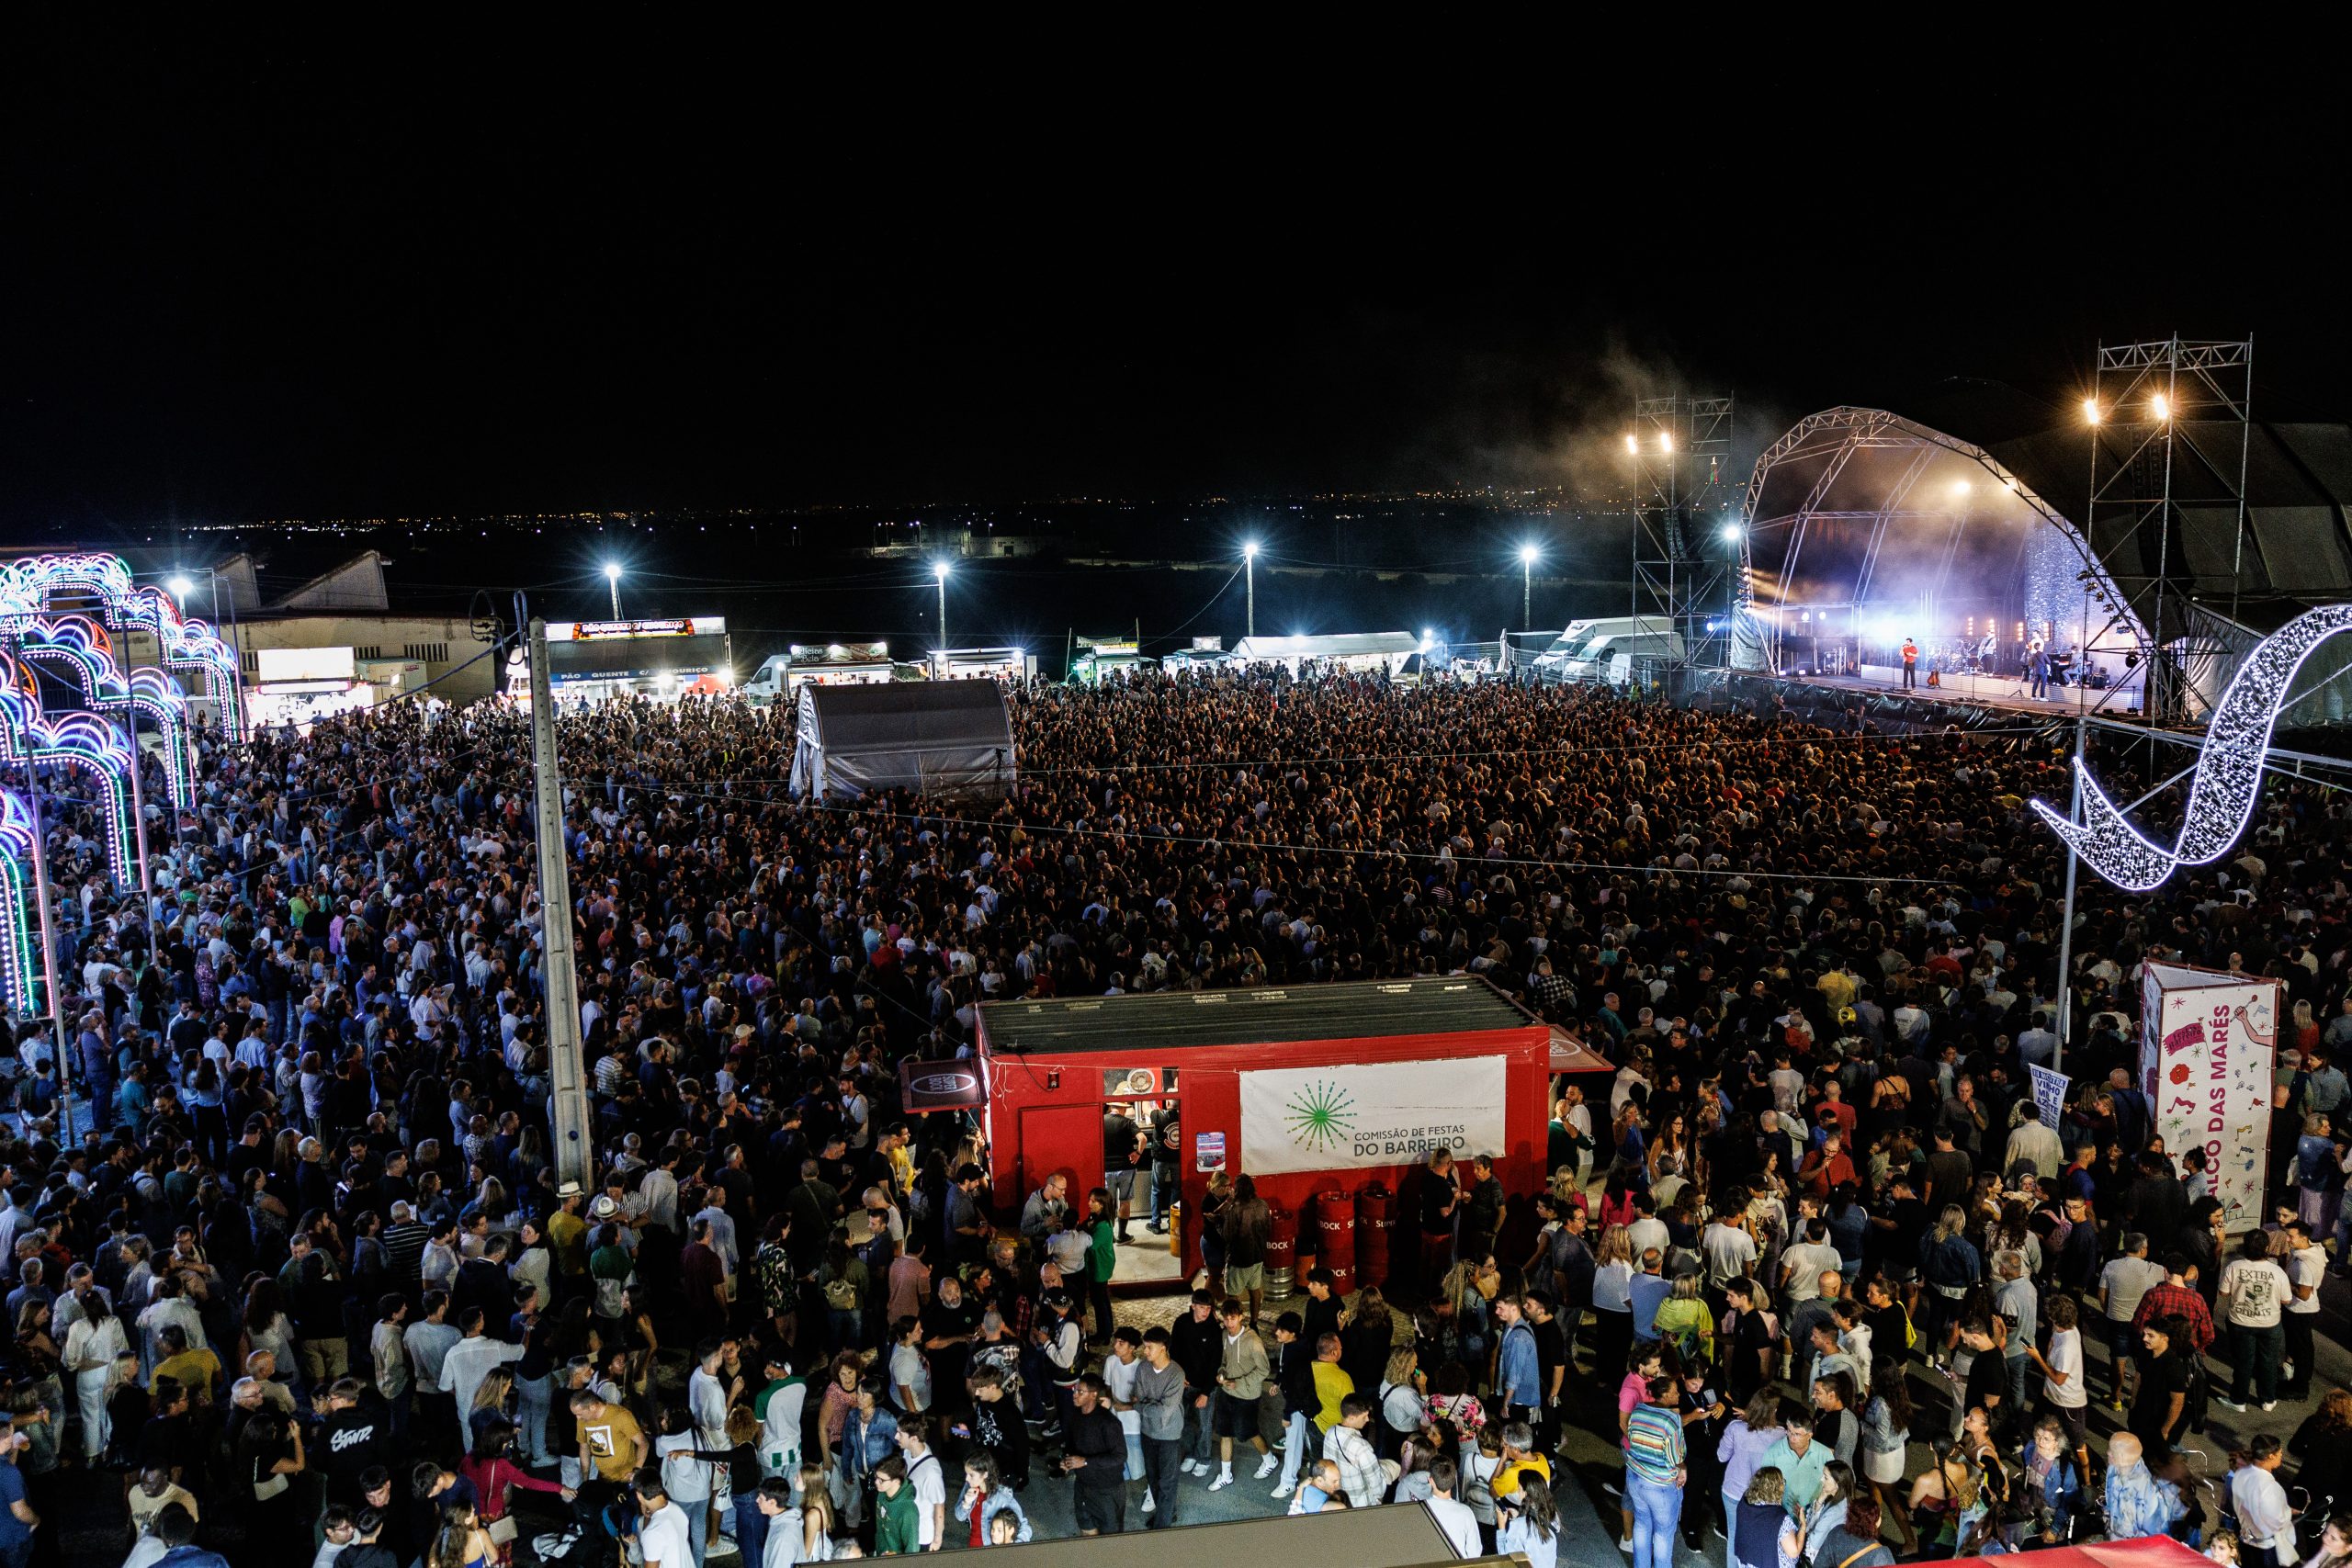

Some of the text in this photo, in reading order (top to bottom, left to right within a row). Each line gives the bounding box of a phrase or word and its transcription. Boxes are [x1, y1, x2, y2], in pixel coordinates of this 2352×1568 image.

[2208, 1004, 2231, 1080] MARÉS
[2207, 1087, 2226, 1132] DAS
[1354, 1124, 1465, 1141] COMISSÃO DE FESTAS
[1354, 1136, 1465, 1156] DO BARREIRO
[2205, 1139, 2222, 1196] ALCO
[1319, 1220, 1340, 1231] BOCK
[1266, 1240, 1288, 1250] BOCK
[2239, 1269, 2275, 1280] EXTRA
